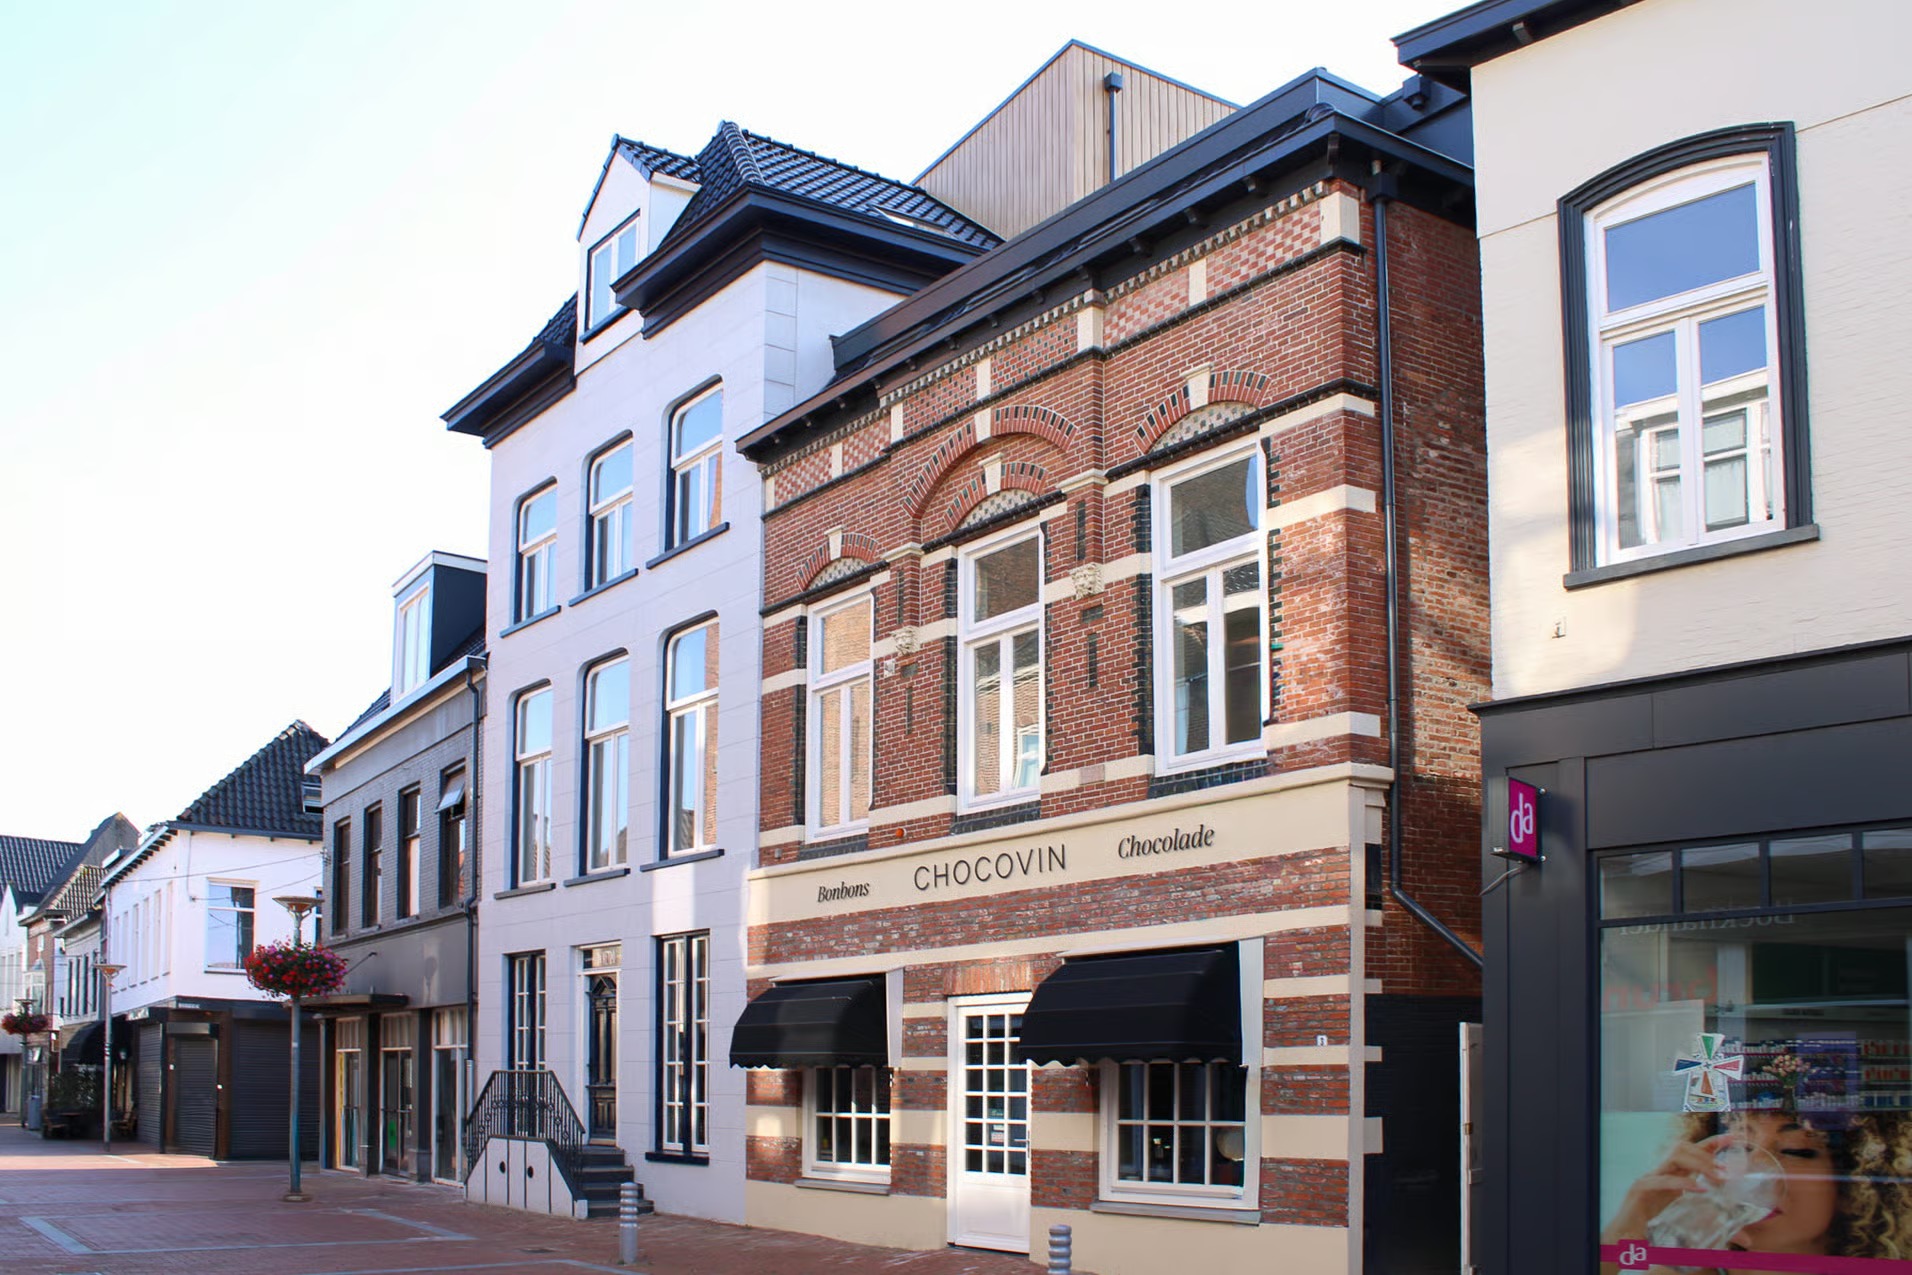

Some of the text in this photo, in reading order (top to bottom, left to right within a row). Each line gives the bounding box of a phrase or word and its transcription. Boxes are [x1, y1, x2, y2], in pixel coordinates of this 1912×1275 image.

[1510, 792, 1534, 844] da
[1118, 823, 1215, 859] Chocolade
[914, 843, 1066, 891] CHOCOVIN
[817, 881, 870, 903] Bonbons
[1619, 1243, 1647, 1266] da
